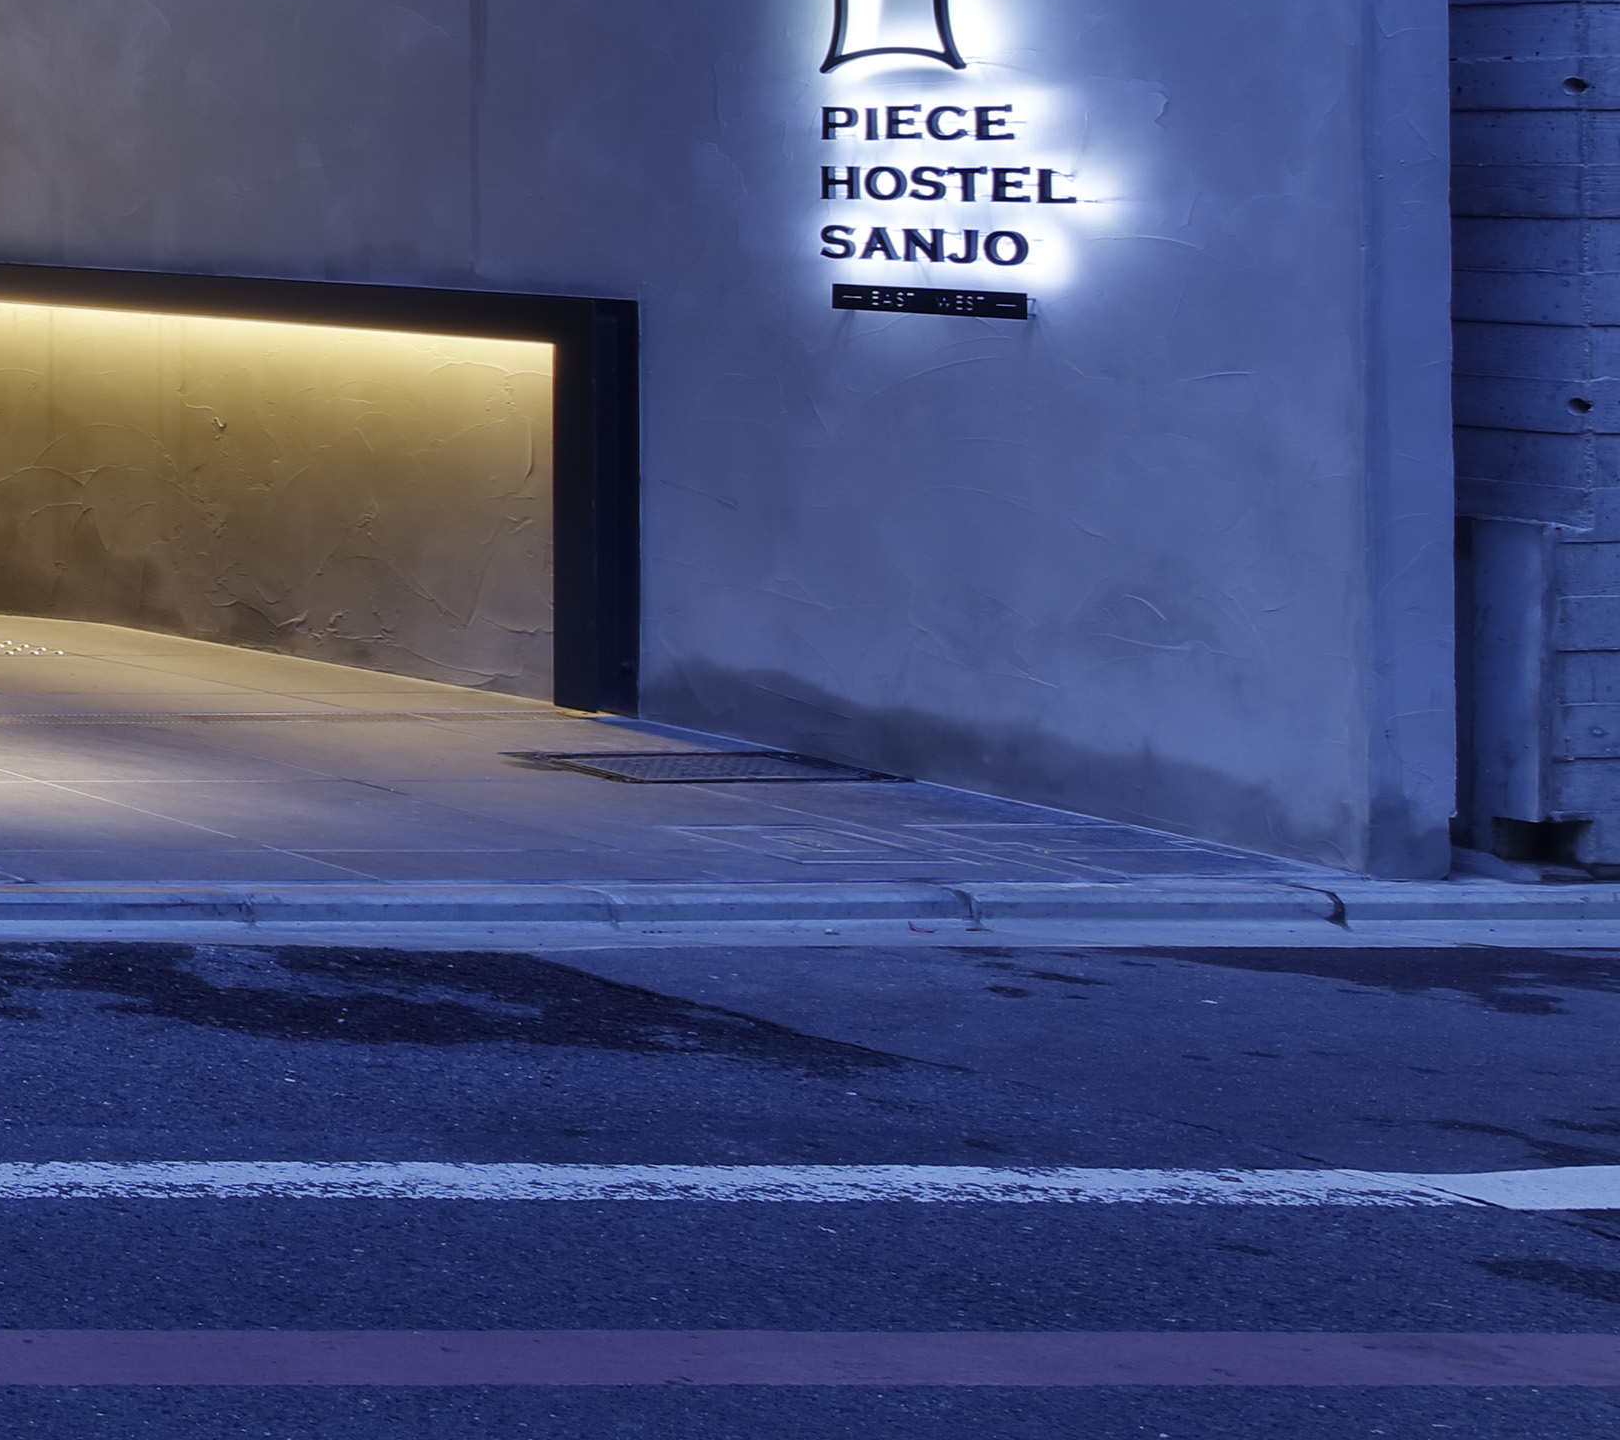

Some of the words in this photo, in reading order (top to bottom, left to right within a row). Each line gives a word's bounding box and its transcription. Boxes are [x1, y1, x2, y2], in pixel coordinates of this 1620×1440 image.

[821, 104, 1015, 141] PIECE
[820, 165, 1077, 203] HOSTEL
[820, 225, 1029, 266] SANJO
